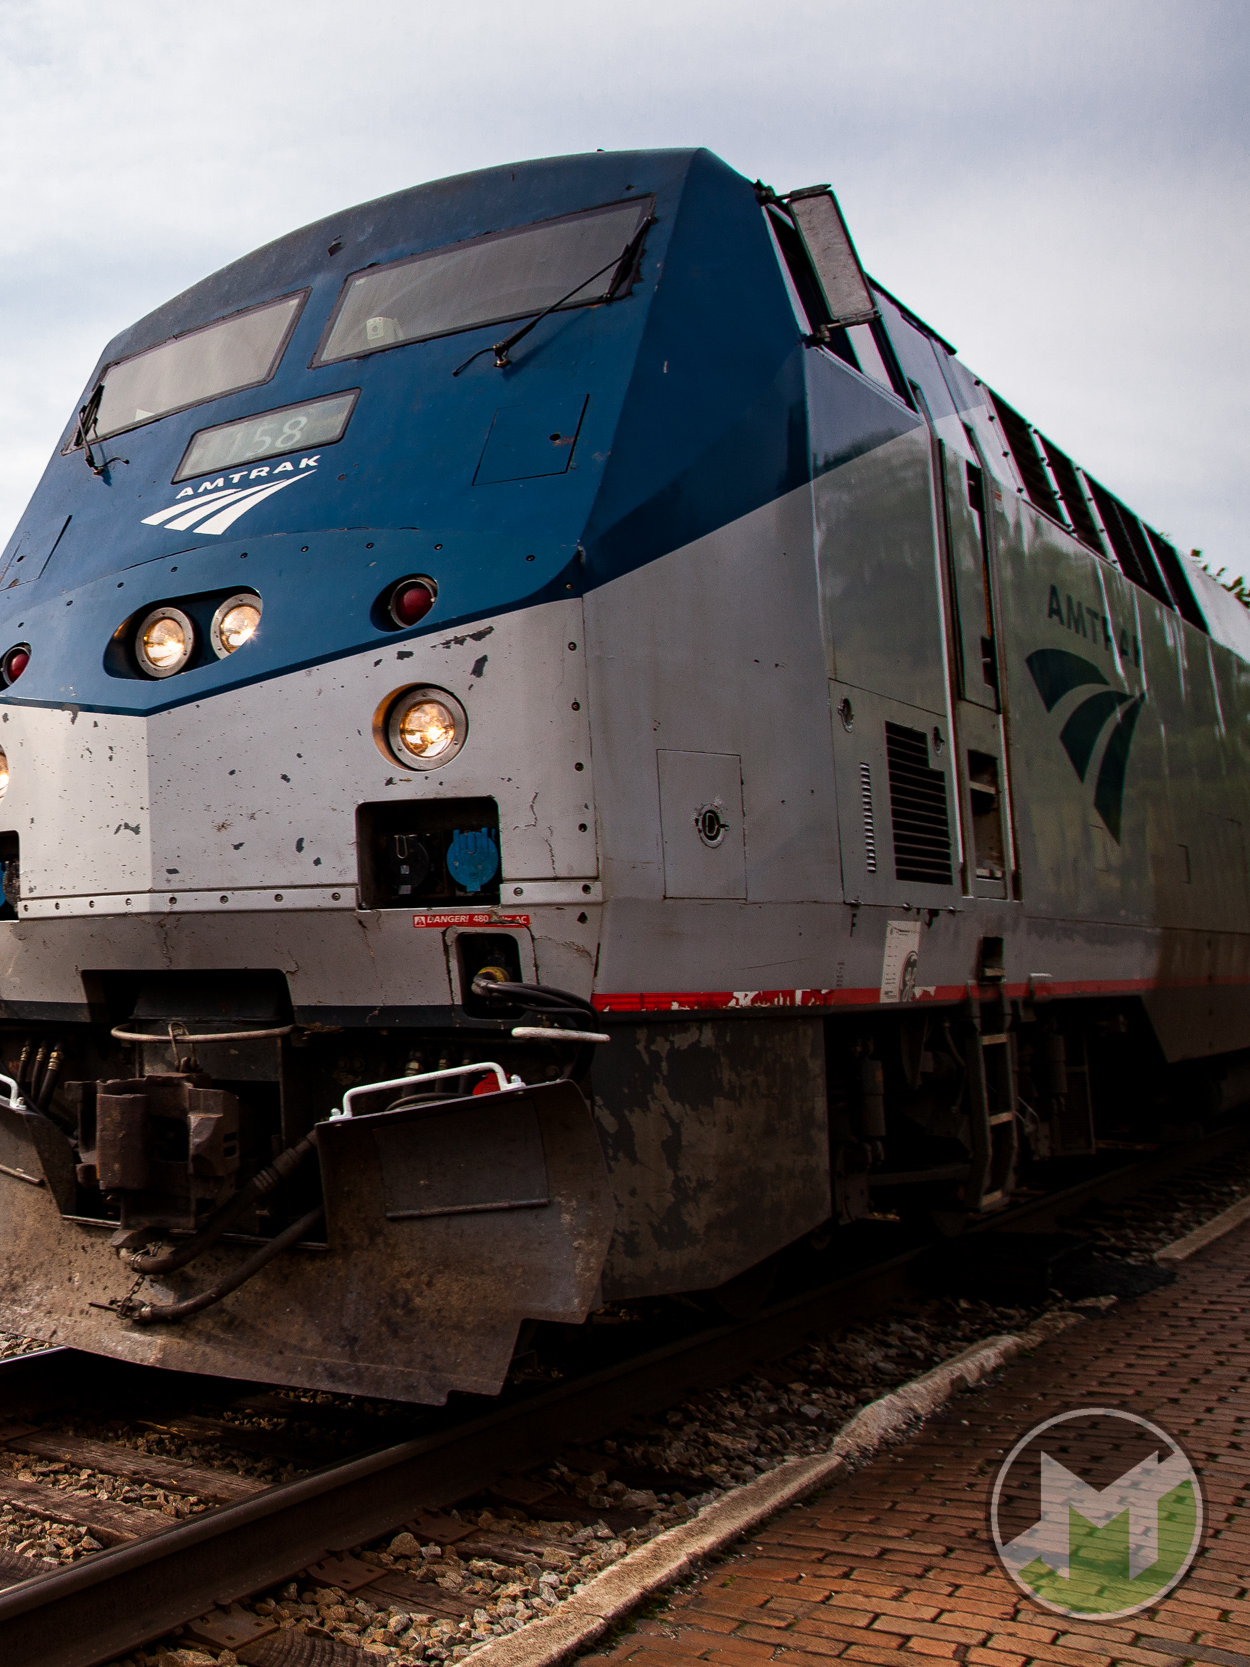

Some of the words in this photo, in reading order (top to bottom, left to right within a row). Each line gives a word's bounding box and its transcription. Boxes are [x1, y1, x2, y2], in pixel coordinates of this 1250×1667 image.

[175, 455, 321, 499] AMTRAK
[427, 914, 470, 924] DANGER!
[472, 914, 489, 923] 480
